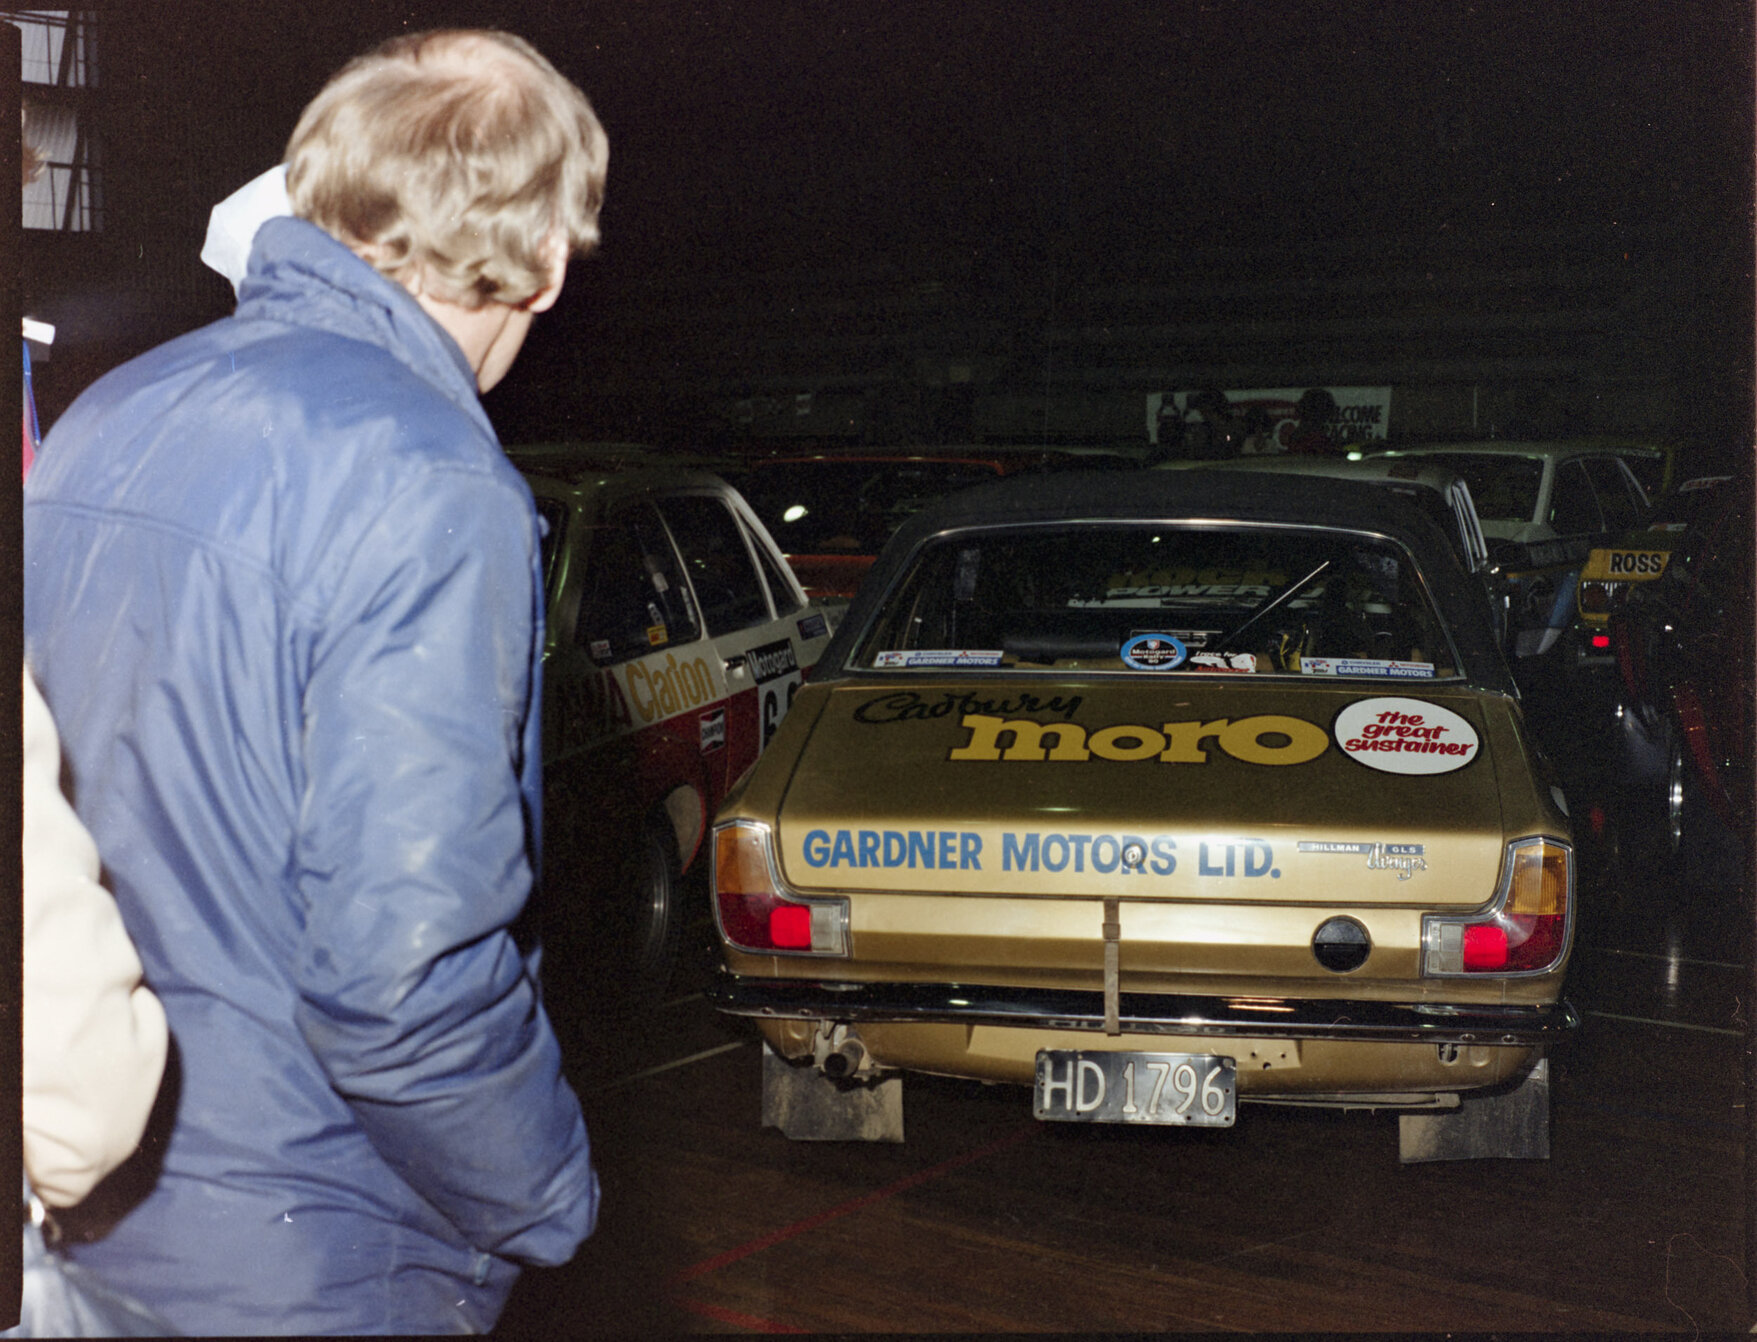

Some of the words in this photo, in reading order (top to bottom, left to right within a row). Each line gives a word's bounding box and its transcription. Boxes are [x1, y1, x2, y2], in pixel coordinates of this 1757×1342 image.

[1609, 552, 1662, 574] ROSS
[1106, 584, 1272, 598] POWER
[1337, 665, 1389, 675] GARDNER
[1390, 668, 1433, 678] MOTORS
[625, 653, 717, 722] Clarion
[854, 692, 1084, 724] Cadbury
[1376, 711, 1425, 726] the
[947, 712, 1331, 767] moro
[1362, 724, 1450, 739] great
[1345, 738, 1474, 756] sustainer
[802, 829, 983, 871] GARDNER
[1001, 832, 1177, 876] MOTORS
[1198, 838, 1281, 878] LTD.
[1311, 843, 1360, 852] HILLMAN
[1043, 1060, 1106, 1112] HD
[1122, 1061, 1226, 1116] 1796
